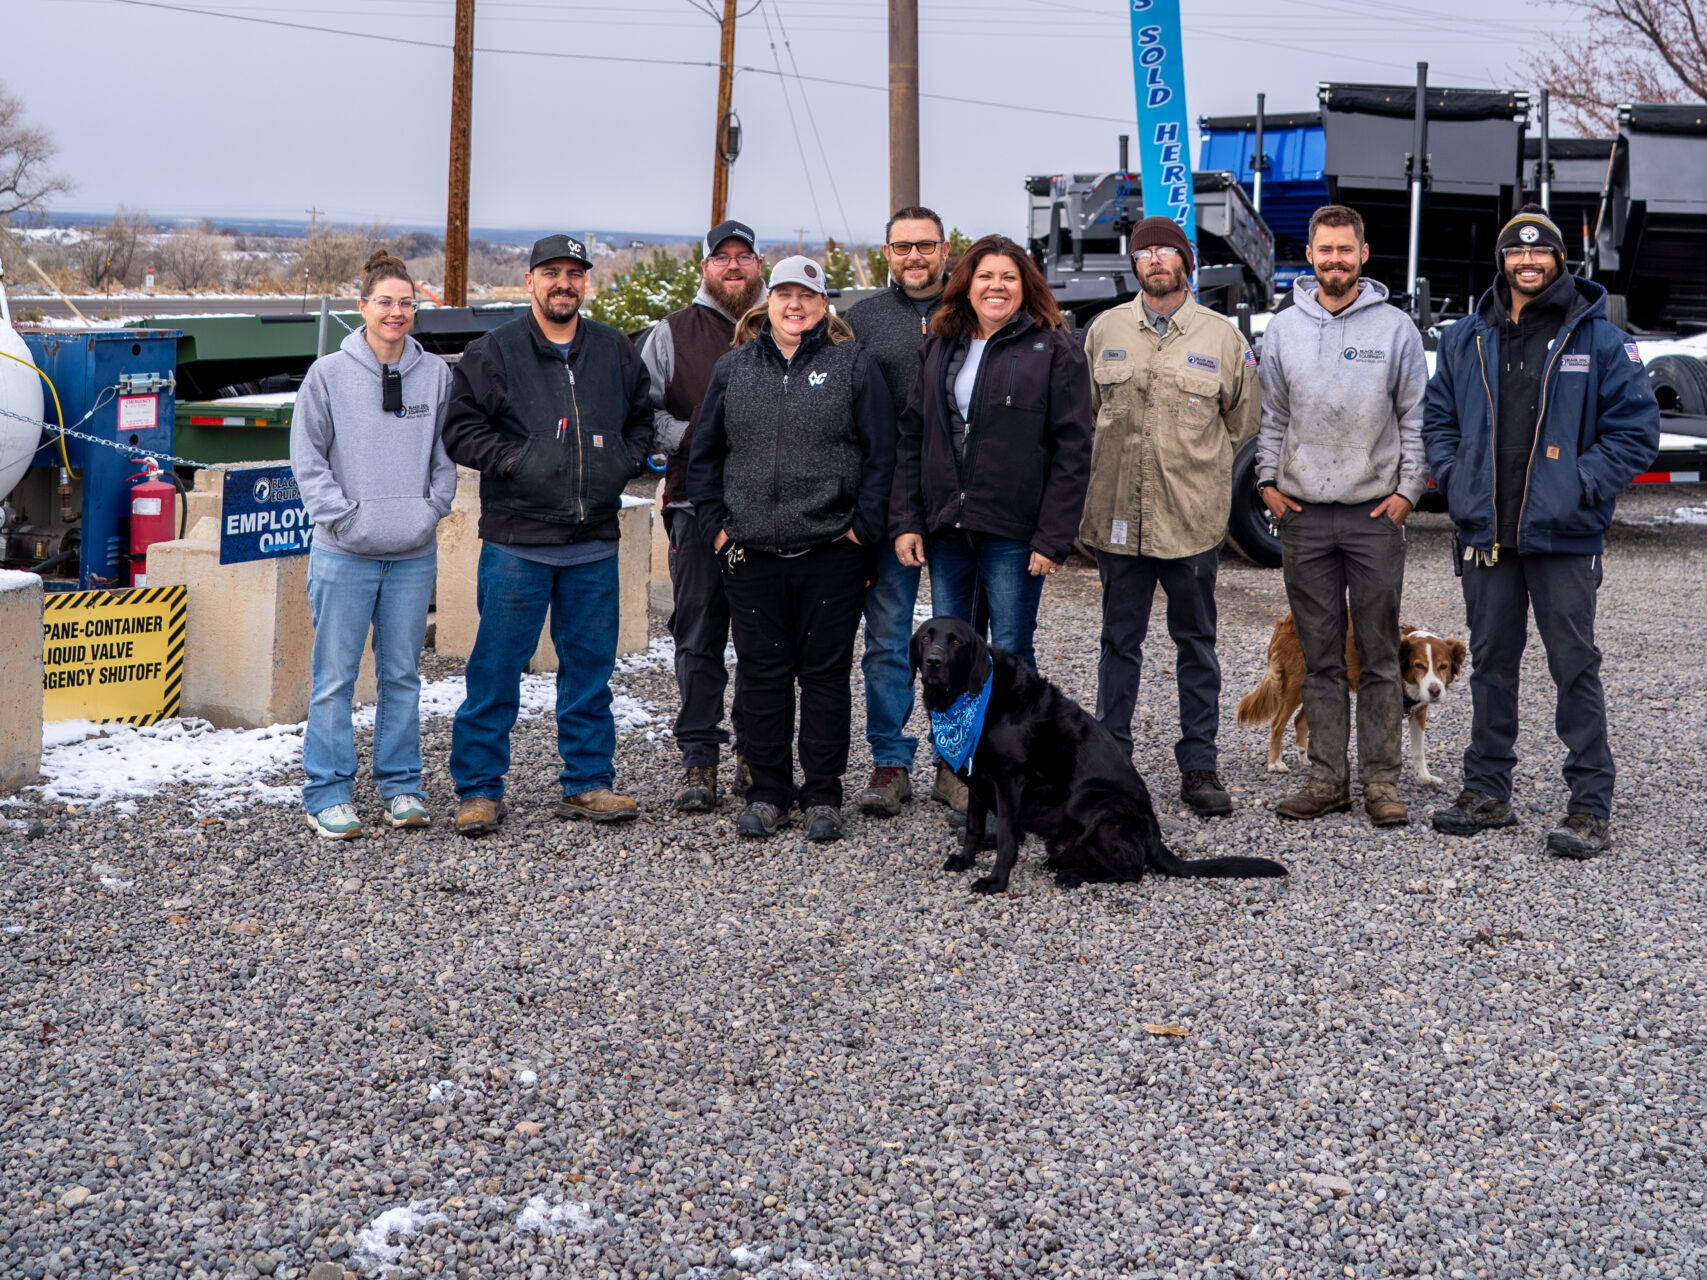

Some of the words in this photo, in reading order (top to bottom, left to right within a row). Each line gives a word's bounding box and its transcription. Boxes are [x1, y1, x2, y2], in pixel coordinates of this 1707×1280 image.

[1138, 25, 1172, 108] SOLD
[1154, 122, 1189, 226] HERE!
[260, 528, 312, 553] ONLY
[91, 641, 134, 660] VALVE
[99, 662, 162, 684] SHUTOFF
